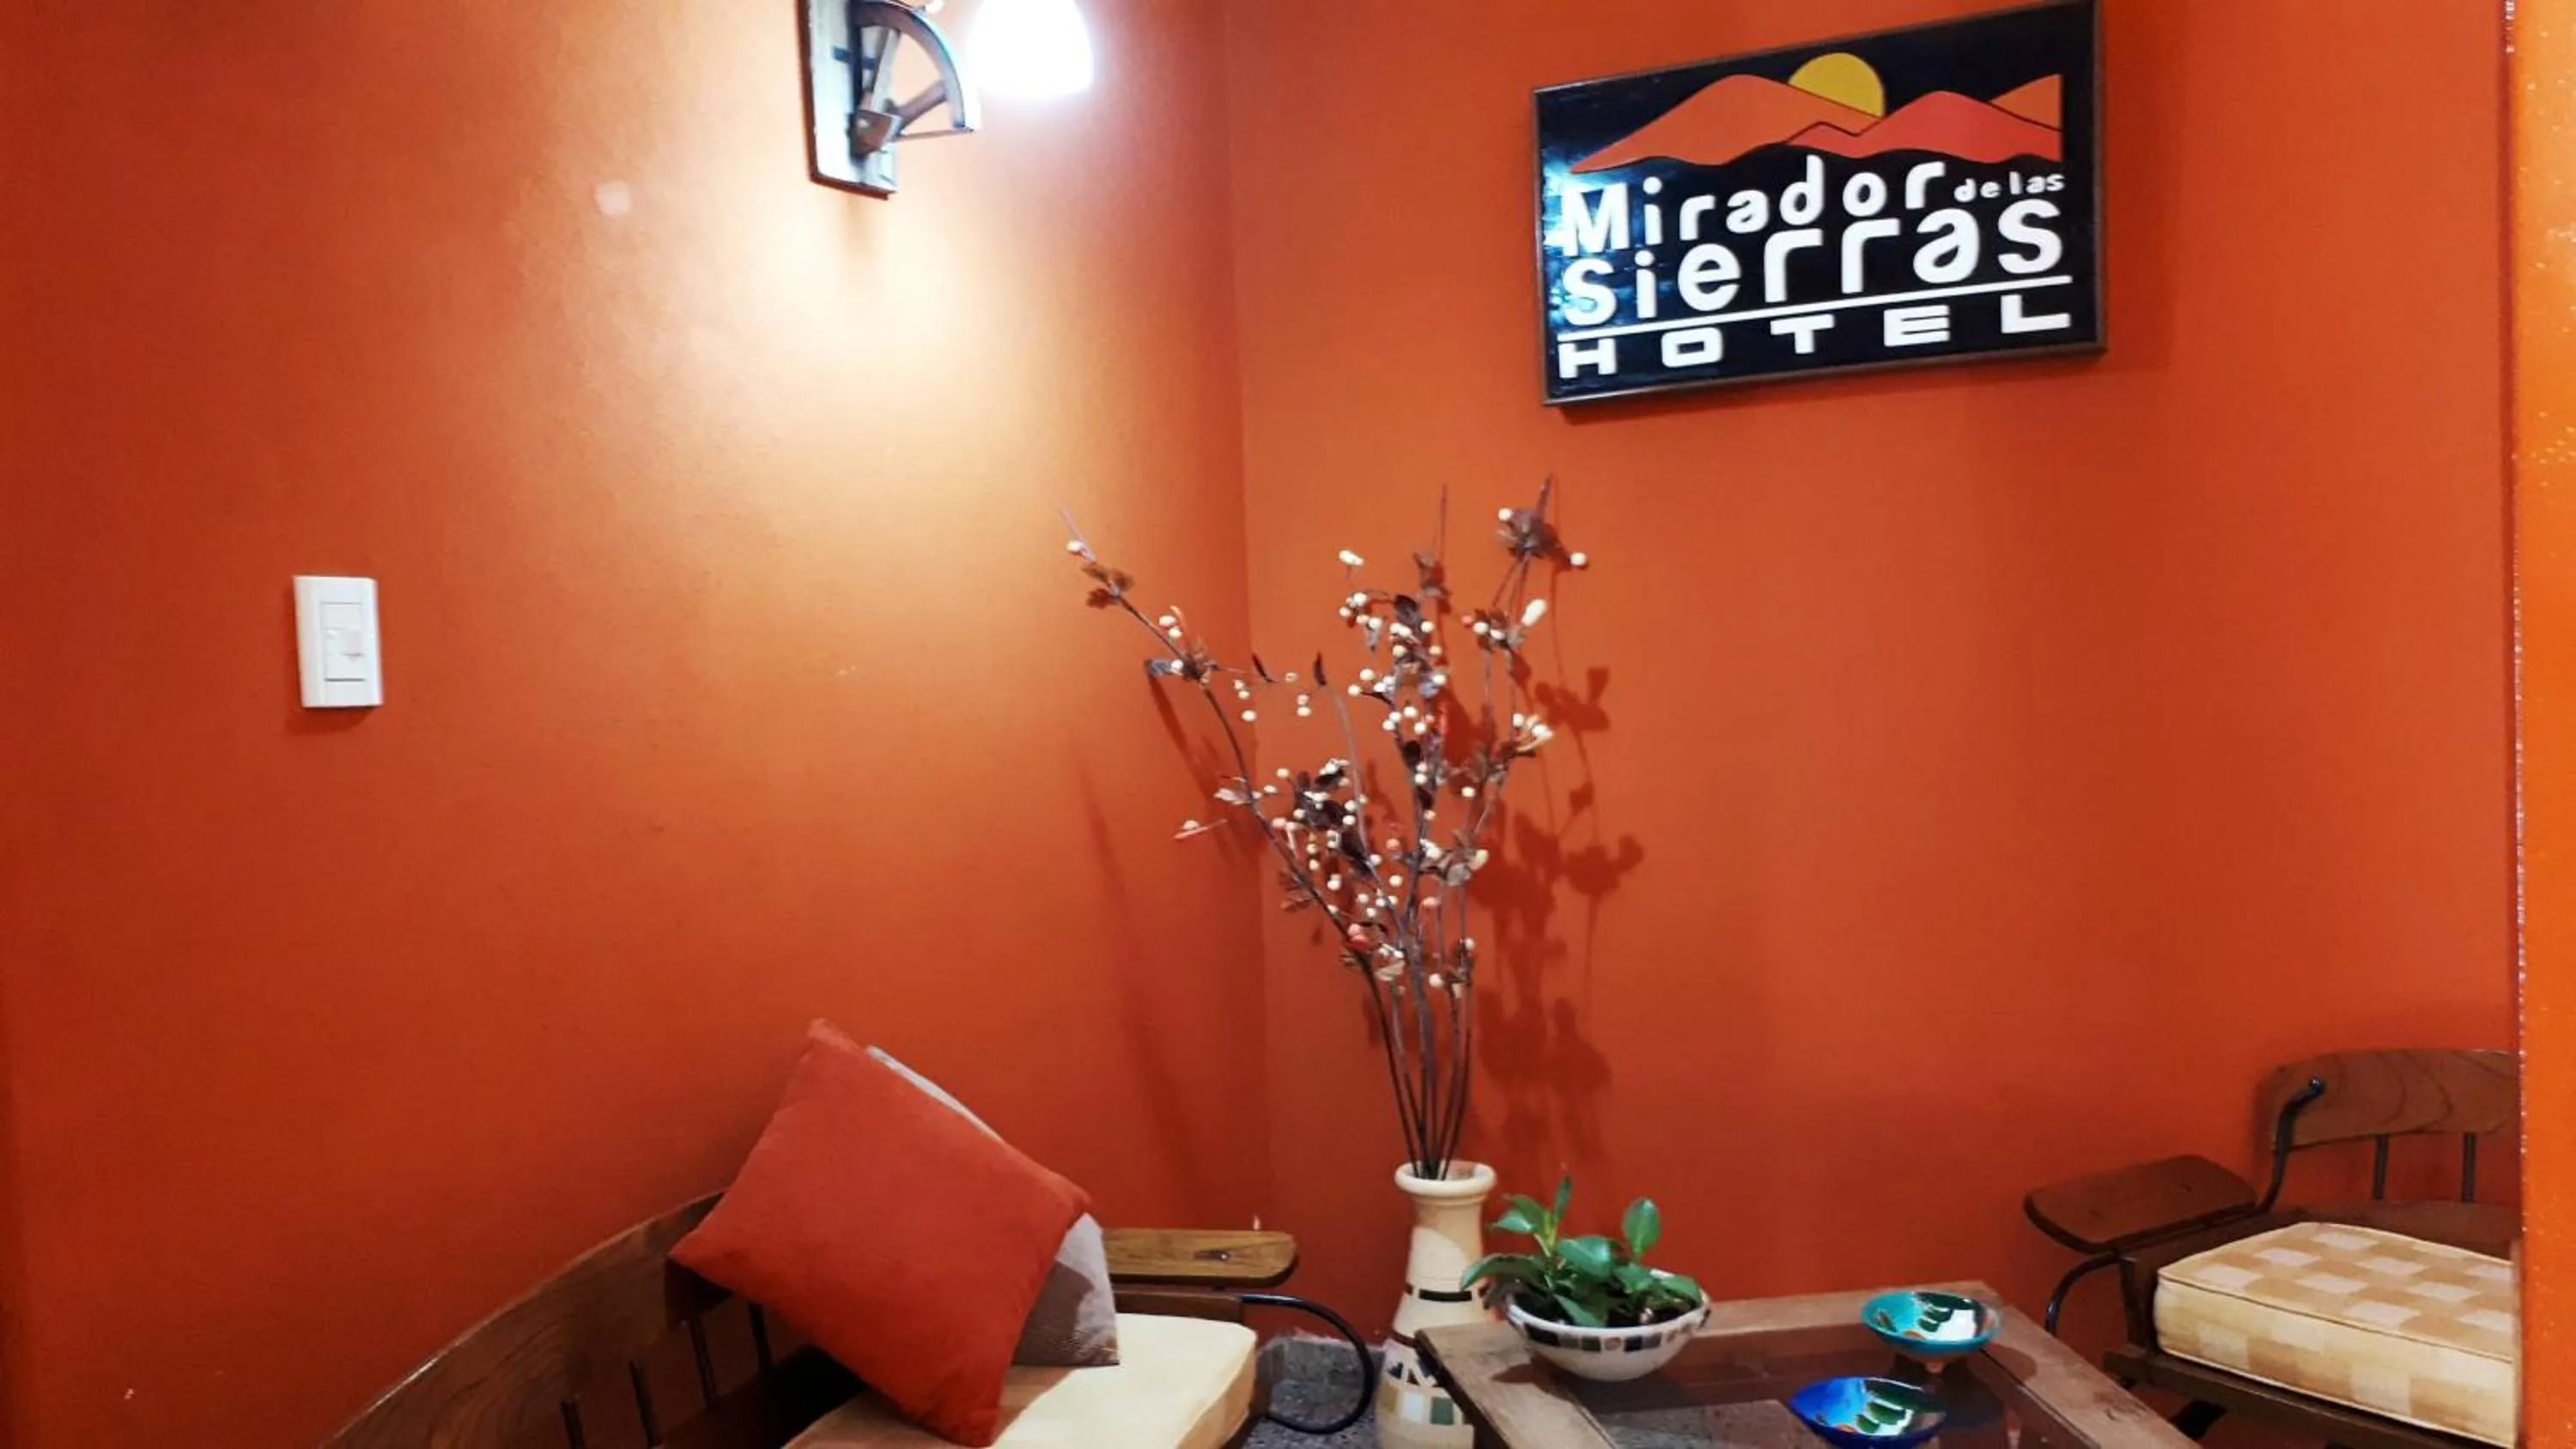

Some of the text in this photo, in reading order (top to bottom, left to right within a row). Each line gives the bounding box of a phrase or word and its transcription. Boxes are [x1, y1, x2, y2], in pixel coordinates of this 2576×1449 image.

[1561, 155, 2066, 256] Mirador de las
[1560, 198, 2063, 326] Sierras
[1558, 294, 2072, 379] HOTEL
